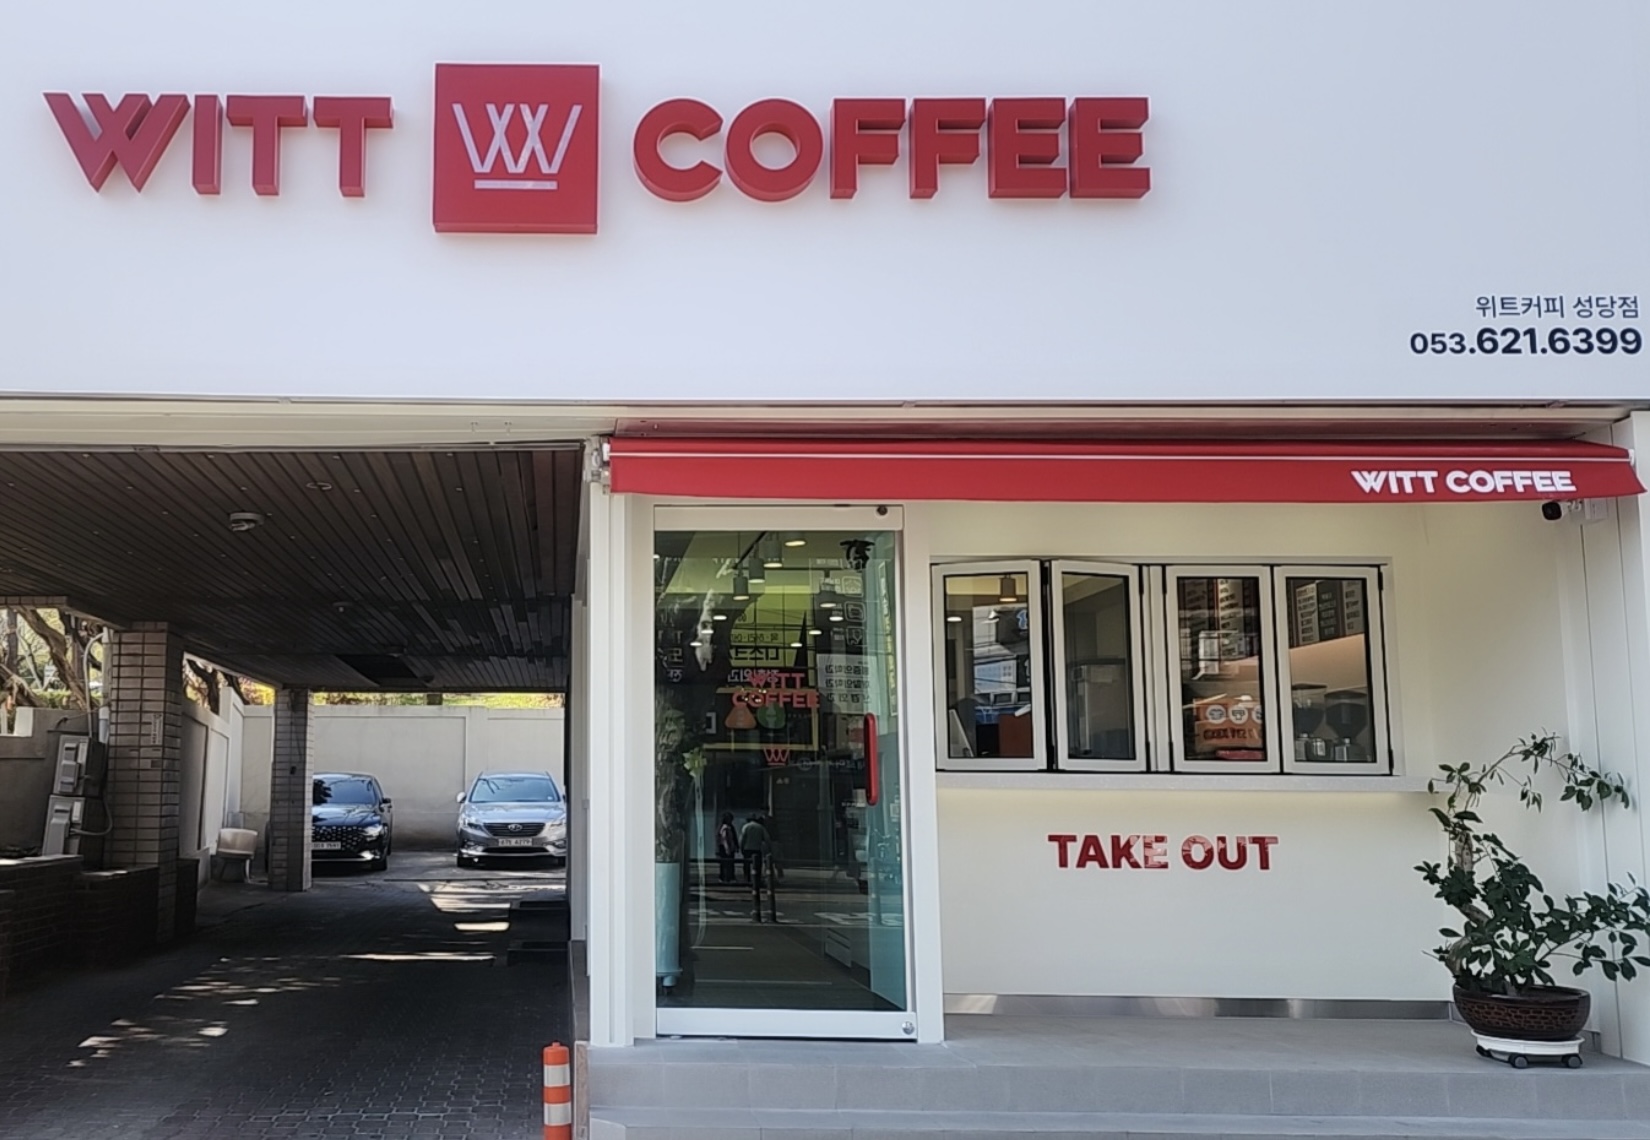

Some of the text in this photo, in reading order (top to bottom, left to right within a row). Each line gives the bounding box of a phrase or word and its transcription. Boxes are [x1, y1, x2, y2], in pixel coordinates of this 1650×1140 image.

[43, 92, 394, 198] WITT
[633, 97, 1151, 202] COFFEE
[1476, 295, 1640, 319] 위트커피 성당점
[1410, 327, 1643, 355] 053.621.6399
[1351, 470, 1577, 494] WITT COFFEE
[749, 673, 805, 689] WITT
[732, 692, 820, 708] COFFEE
[1048, 834, 1279, 870] TAKE OUT
